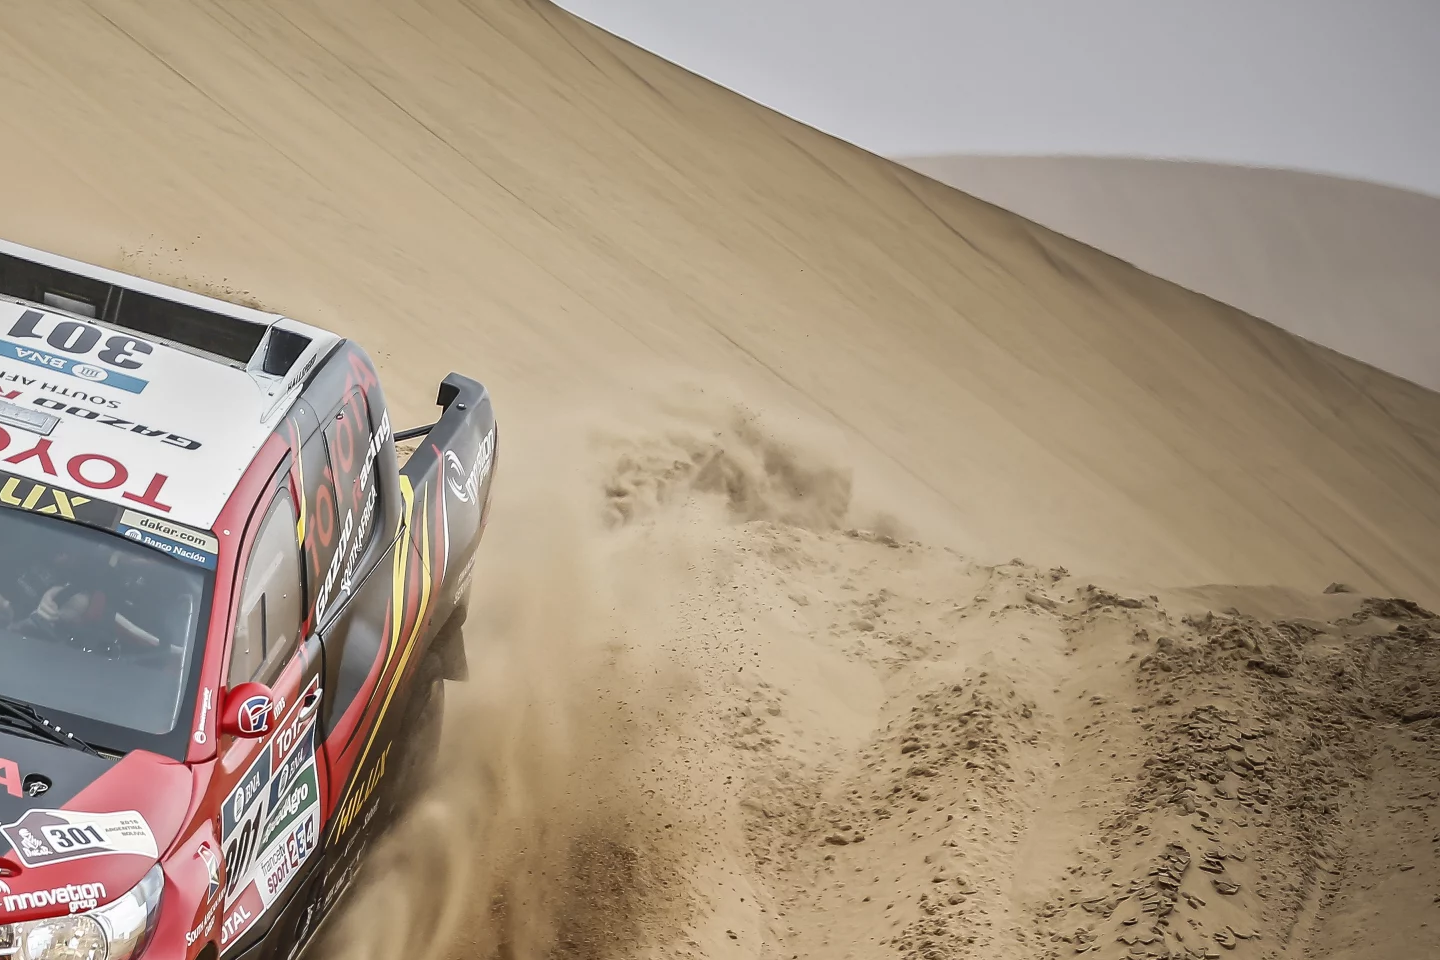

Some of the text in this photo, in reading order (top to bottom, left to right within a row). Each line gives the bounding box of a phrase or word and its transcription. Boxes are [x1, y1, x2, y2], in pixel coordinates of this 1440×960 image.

[7, 309, 153, 369] 301
[15, 346, 68, 369] BNA
[40, 377, 122, 409] SOUTH
[32, 397, 202, 451] GAZOO
[305, 352, 378, 577] TOYOTA
[140, 518, 207, 547] dakar.com
[143, 536, 206, 563] Banco Nación
[315, 508, 353, 625] GAZOO
[49, 825, 106, 849] 301
[267, 860, 290, 895] sport
[2, 882, 107, 912] innovation
[68, 898, 98, 913] group
